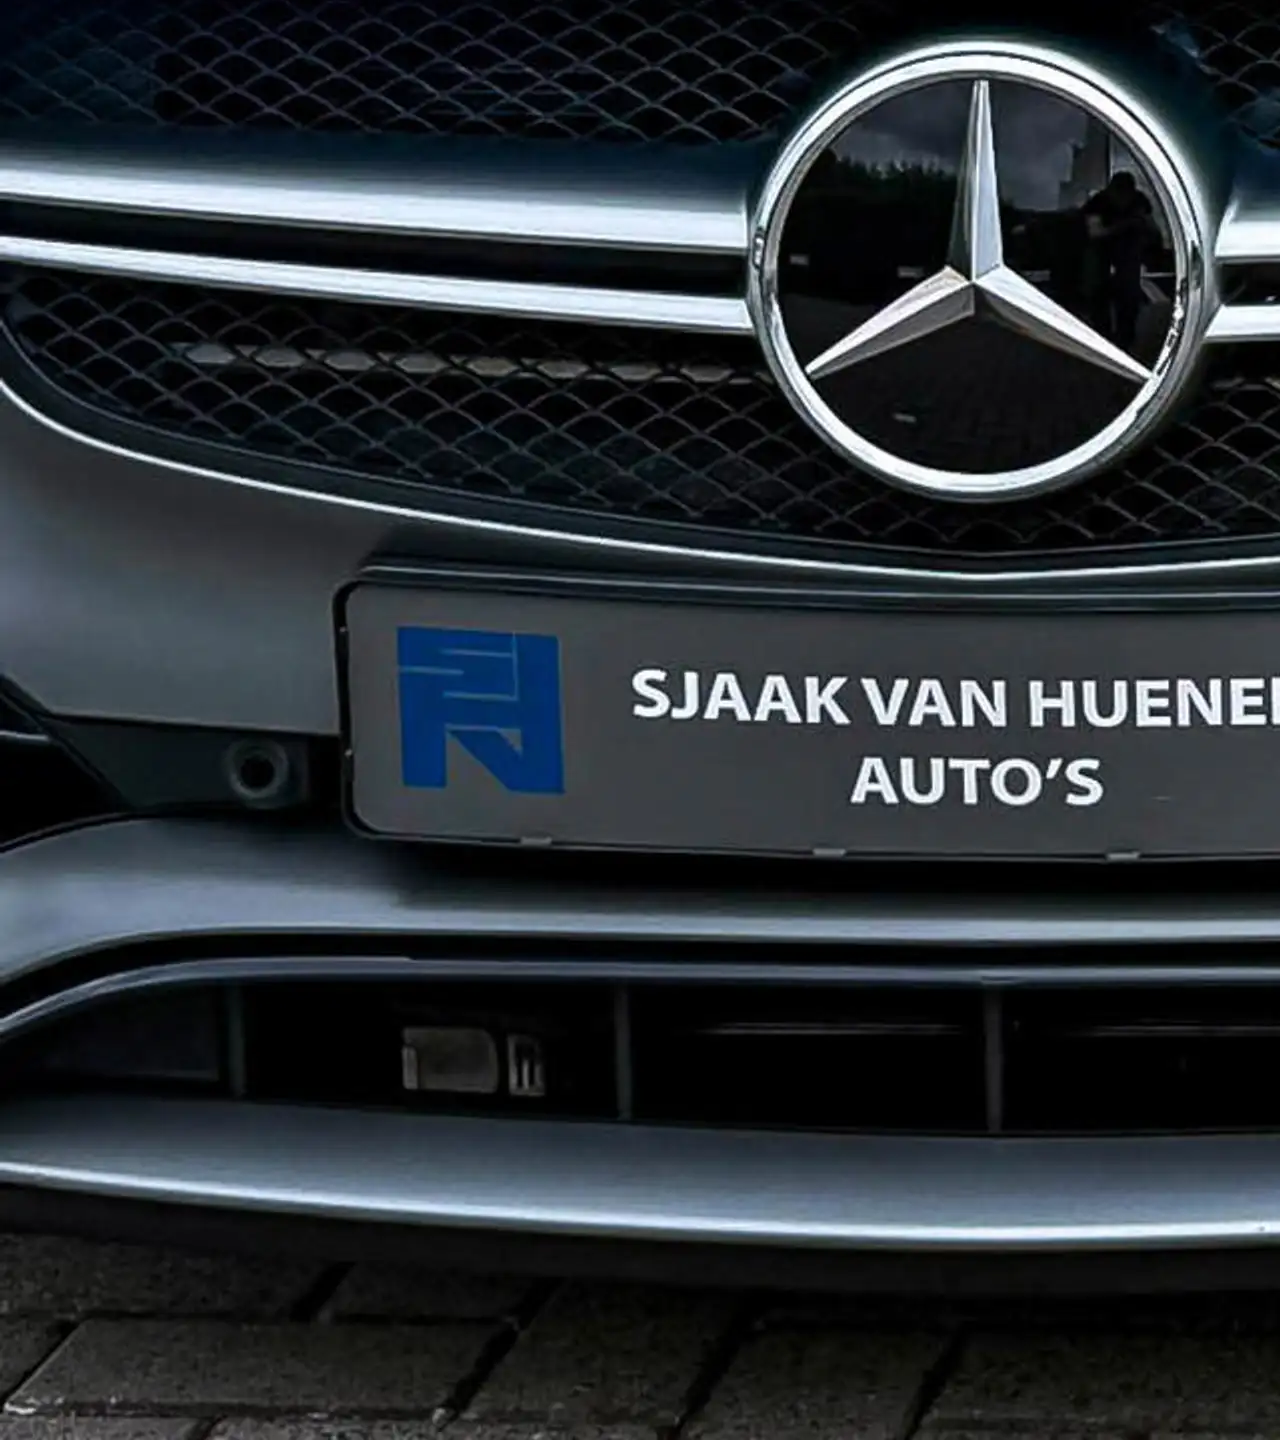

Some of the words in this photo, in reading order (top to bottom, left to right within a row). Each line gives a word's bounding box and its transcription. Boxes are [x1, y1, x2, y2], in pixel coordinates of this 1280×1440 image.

[631, 668, 851, 725] SJAAK
[860, 677, 1007, 728] VAN
[850, 756, 1104, 806] AUTO’S
